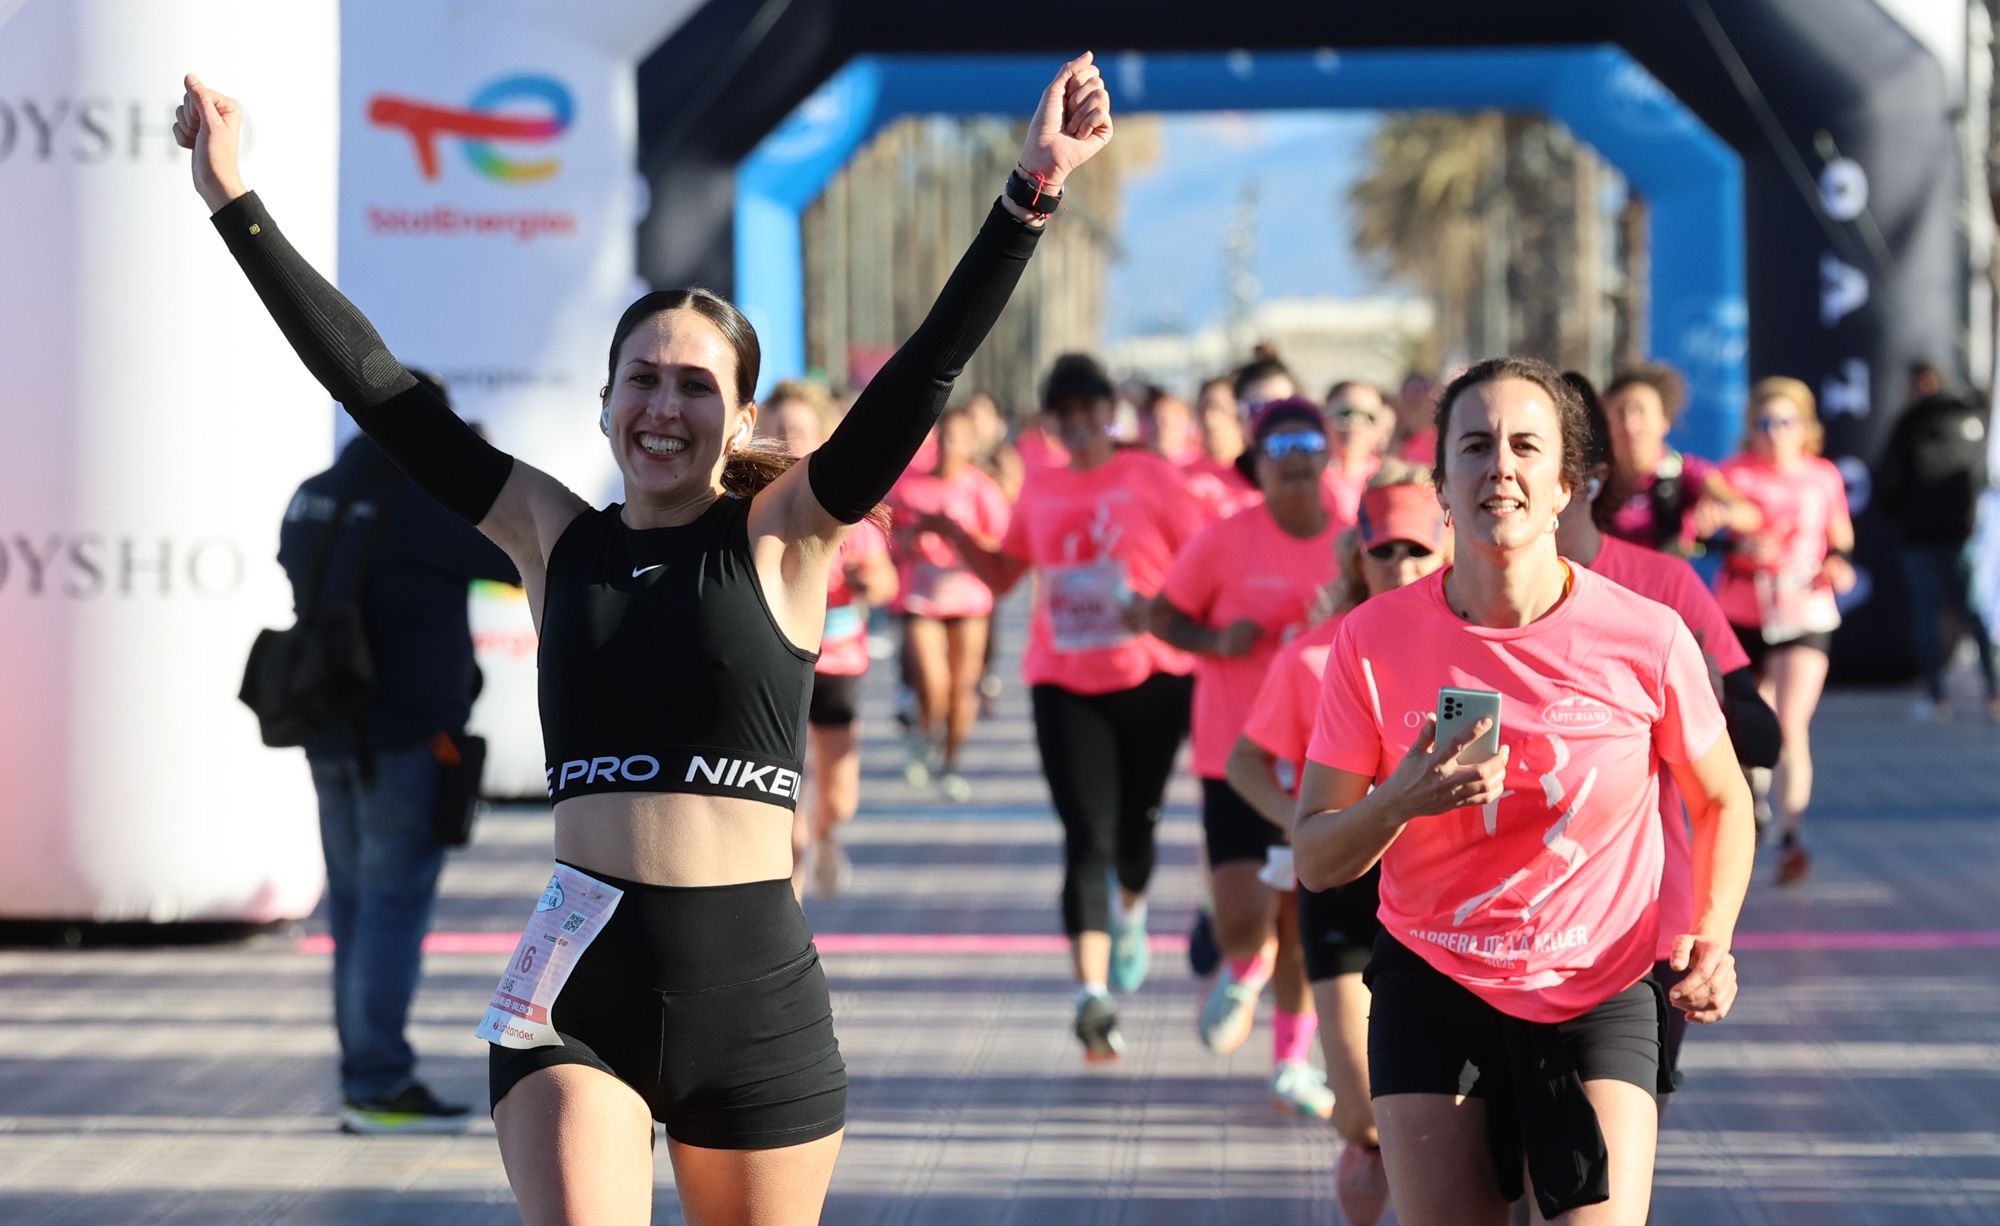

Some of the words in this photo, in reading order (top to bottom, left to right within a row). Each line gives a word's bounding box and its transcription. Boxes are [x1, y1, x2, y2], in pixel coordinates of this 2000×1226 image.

[0, 533, 244, 600] YSHO
[1549, 711, 1606, 722] ASTURIANA
[559, 754, 660, 790] PRO
